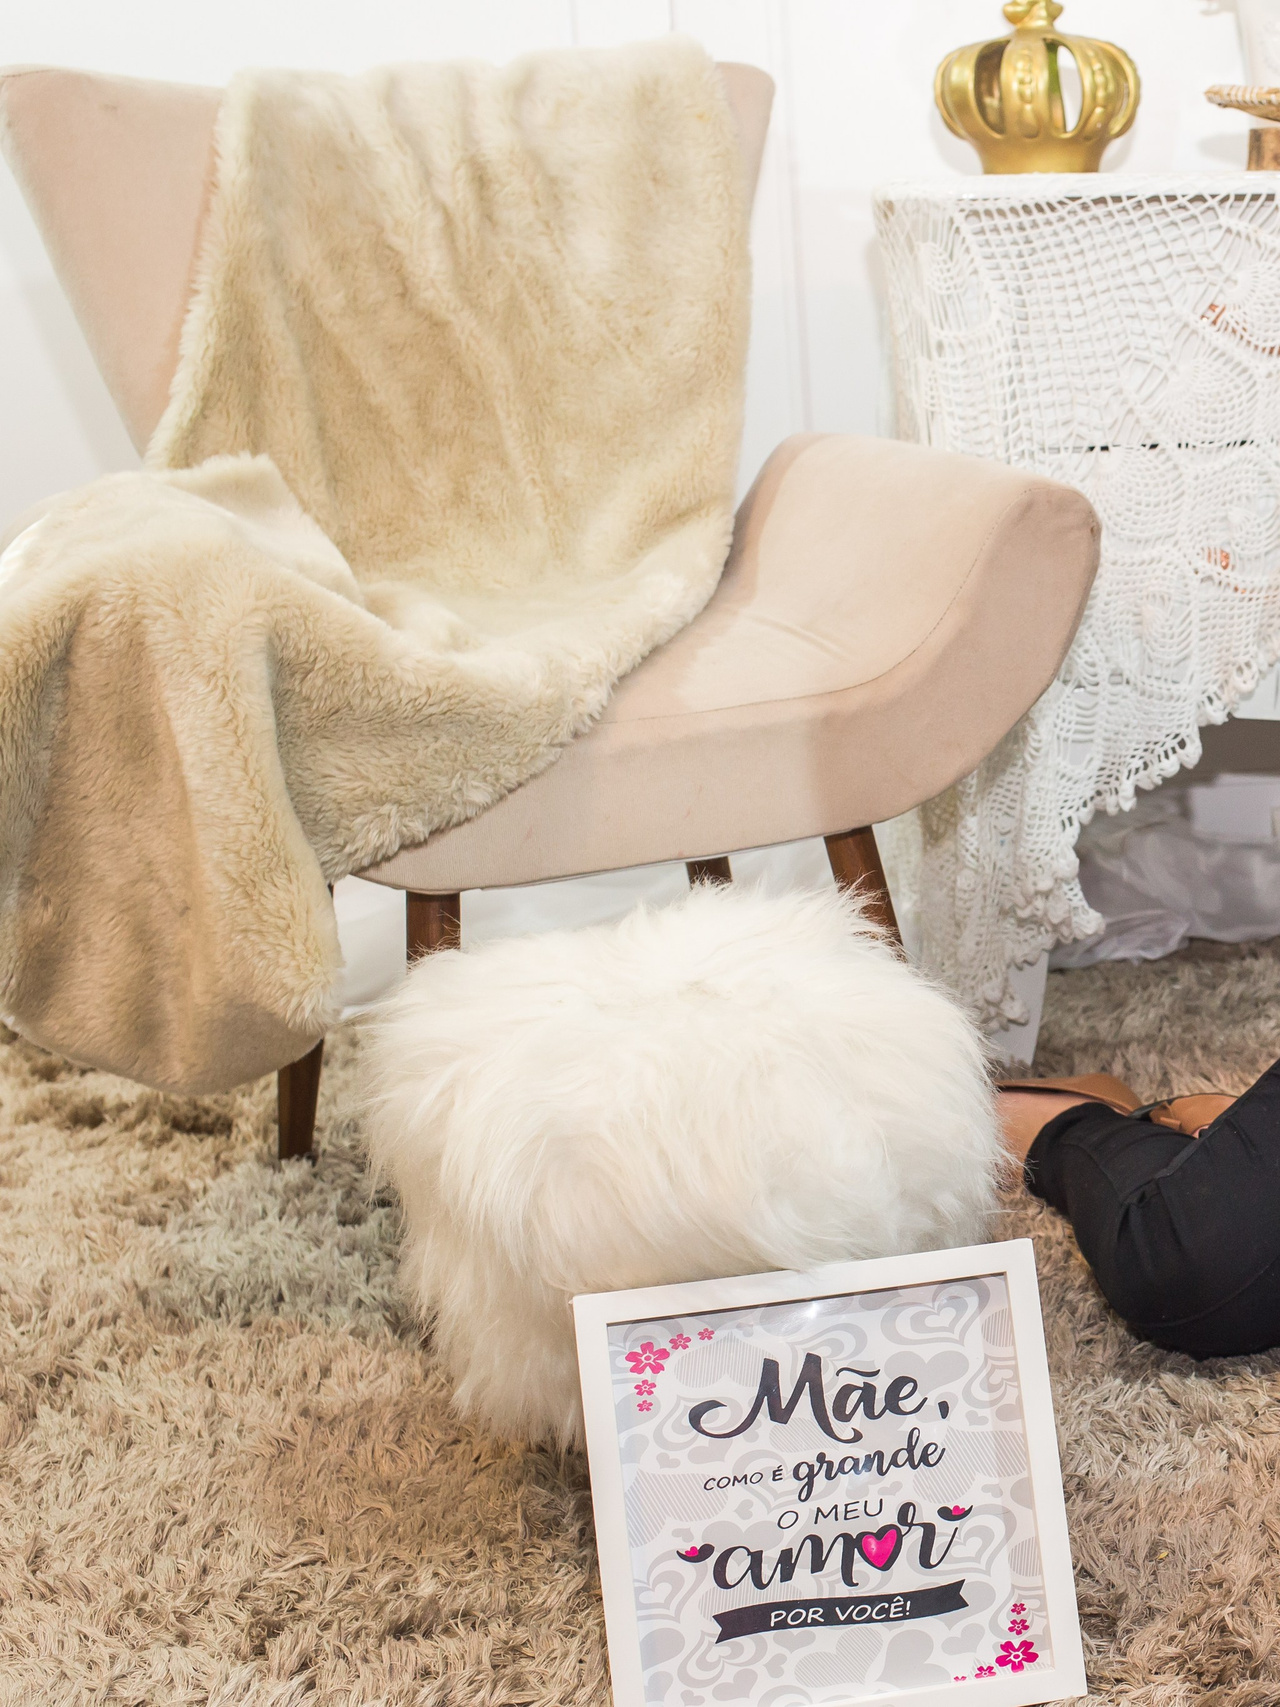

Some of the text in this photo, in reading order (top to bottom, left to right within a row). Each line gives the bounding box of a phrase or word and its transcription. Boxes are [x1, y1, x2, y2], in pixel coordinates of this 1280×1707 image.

[688, 1353, 950, 1443] Mãe,
[703, 1427, 946, 1502] COMO É grande
[712, 1502, 959, 1590] amor
[777, 1499, 884, 1529] O MEU
[770, 1596, 912, 1627] POR VOCÊ!
